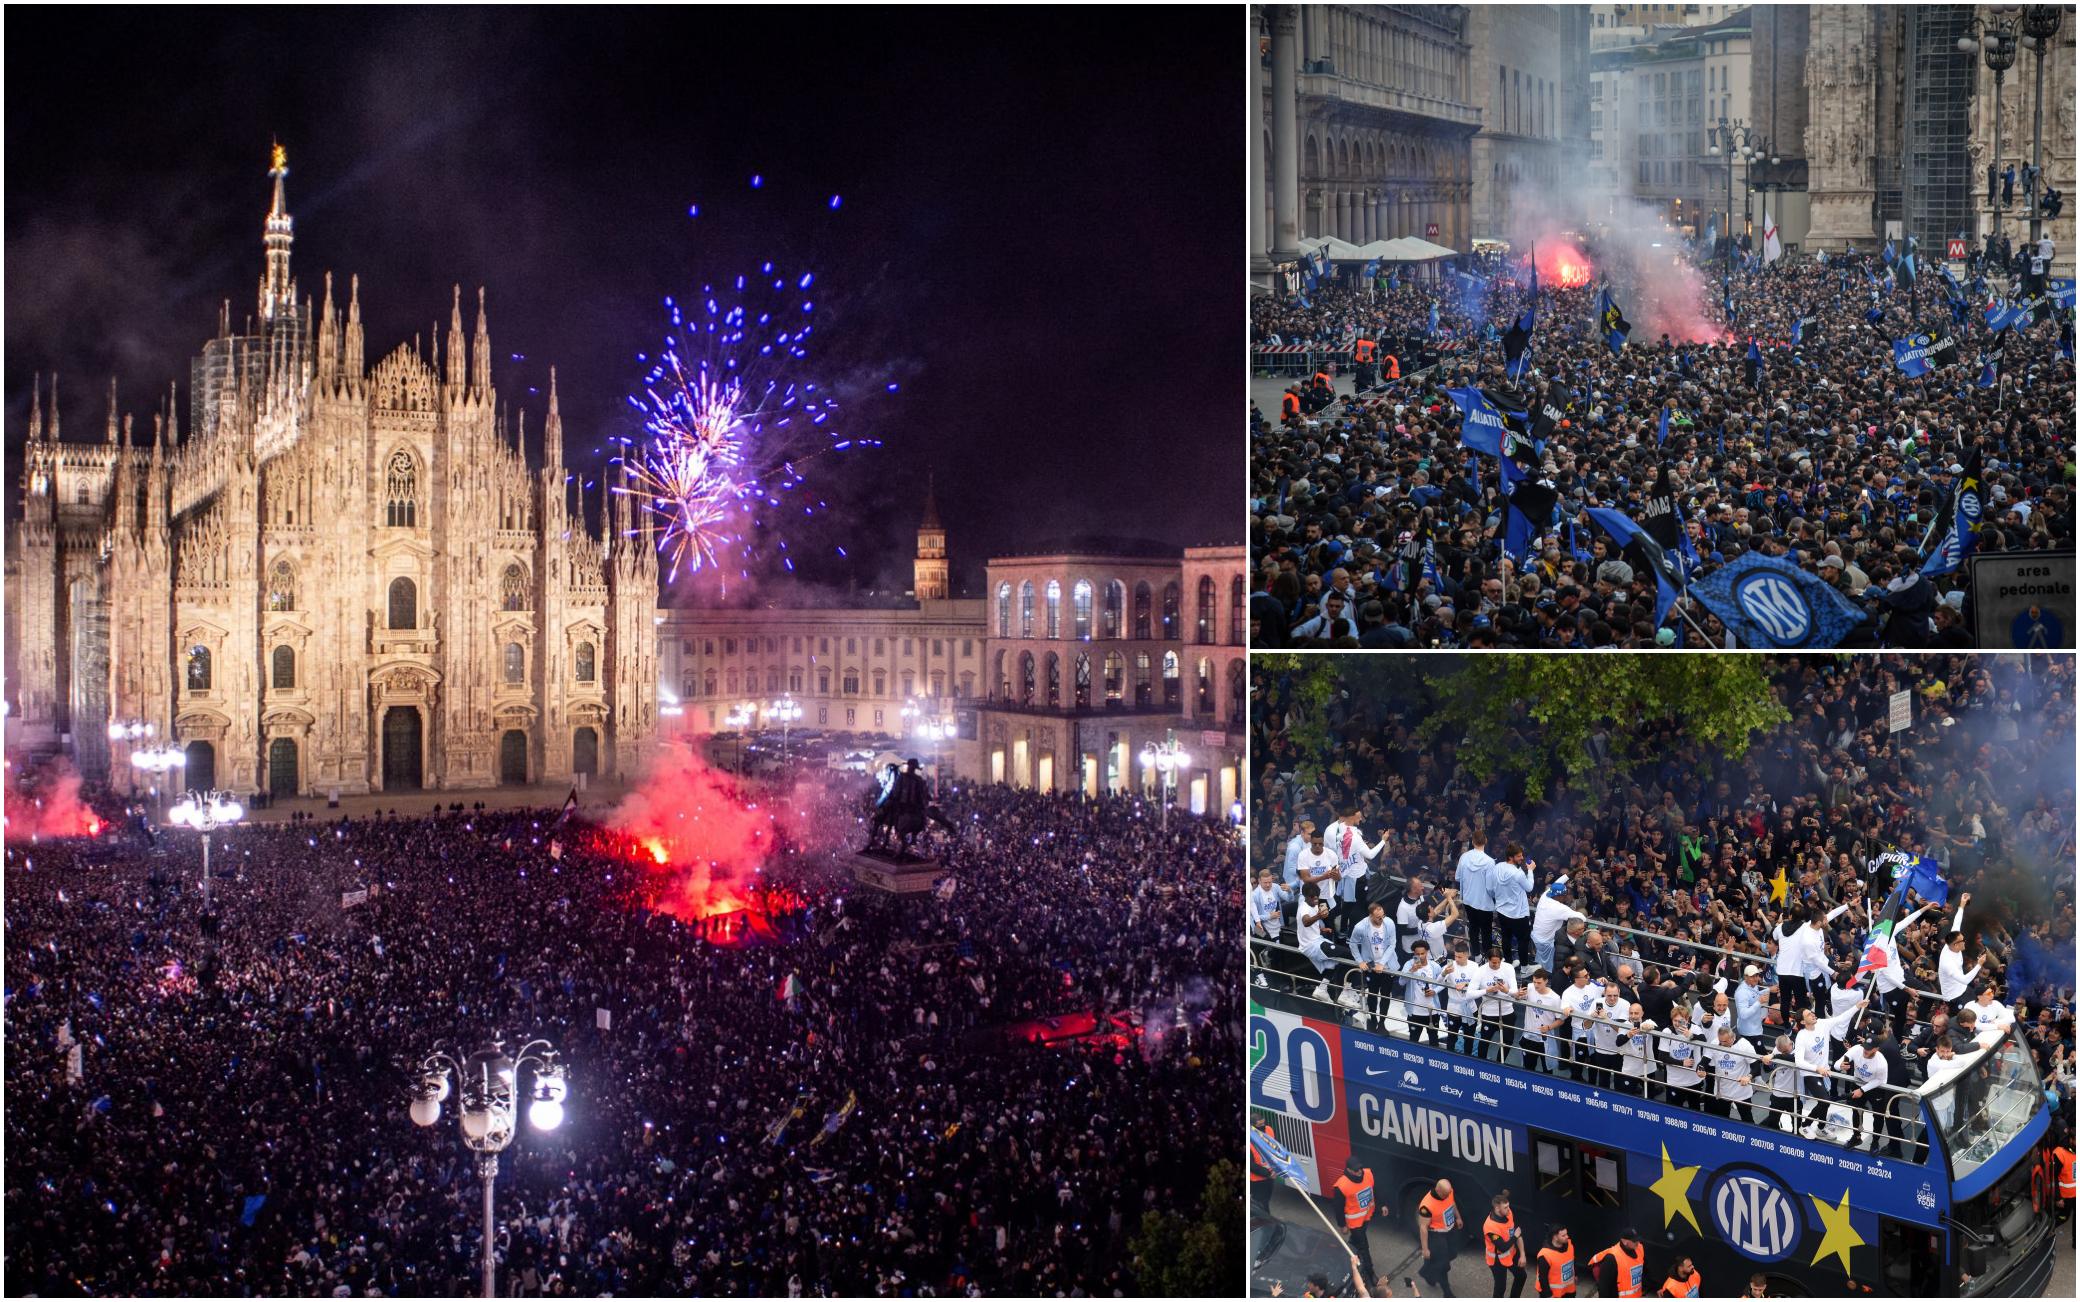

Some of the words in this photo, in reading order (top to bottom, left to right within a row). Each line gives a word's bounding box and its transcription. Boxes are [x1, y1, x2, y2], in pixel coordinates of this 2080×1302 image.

[1428, 226, 1438, 234] M
[1950, 243, 1965, 255] M
[2017, 565, 2050, 577] area
[2000, 582, 2070, 599] pedonale
[1250, 1014, 1336, 1124] 20
[1440, 1085, 1463, 1098] ebay
[1359, 1092, 1515, 1173] CAMPIONI
[1612, 1104, 1632, 1116] 1970/71
[1637, 1110, 1659, 1122] 1979/80
[1665, 1117, 1688, 1129] 1988/89
[1692, 1124, 1716, 1136] 2005/06
[1722, 1131, 1745, 1144] 2006/07
[1751, 1138, 1774, 1151] 2007/08
[1780, 1145, 1804, 1158] 2008/09
[1810, 1152, 1834, 1165] 2009/10
[1839, 1159, 1862, 1172] 2020/21
[1868, 1166, 1892, 1179] 2023/24
[1916, 1188, 1936, 1200] MILAN
[1916, 1194, 1936, 1203] OPEN
[1917, 1199, 1935, 1209] TOUR
